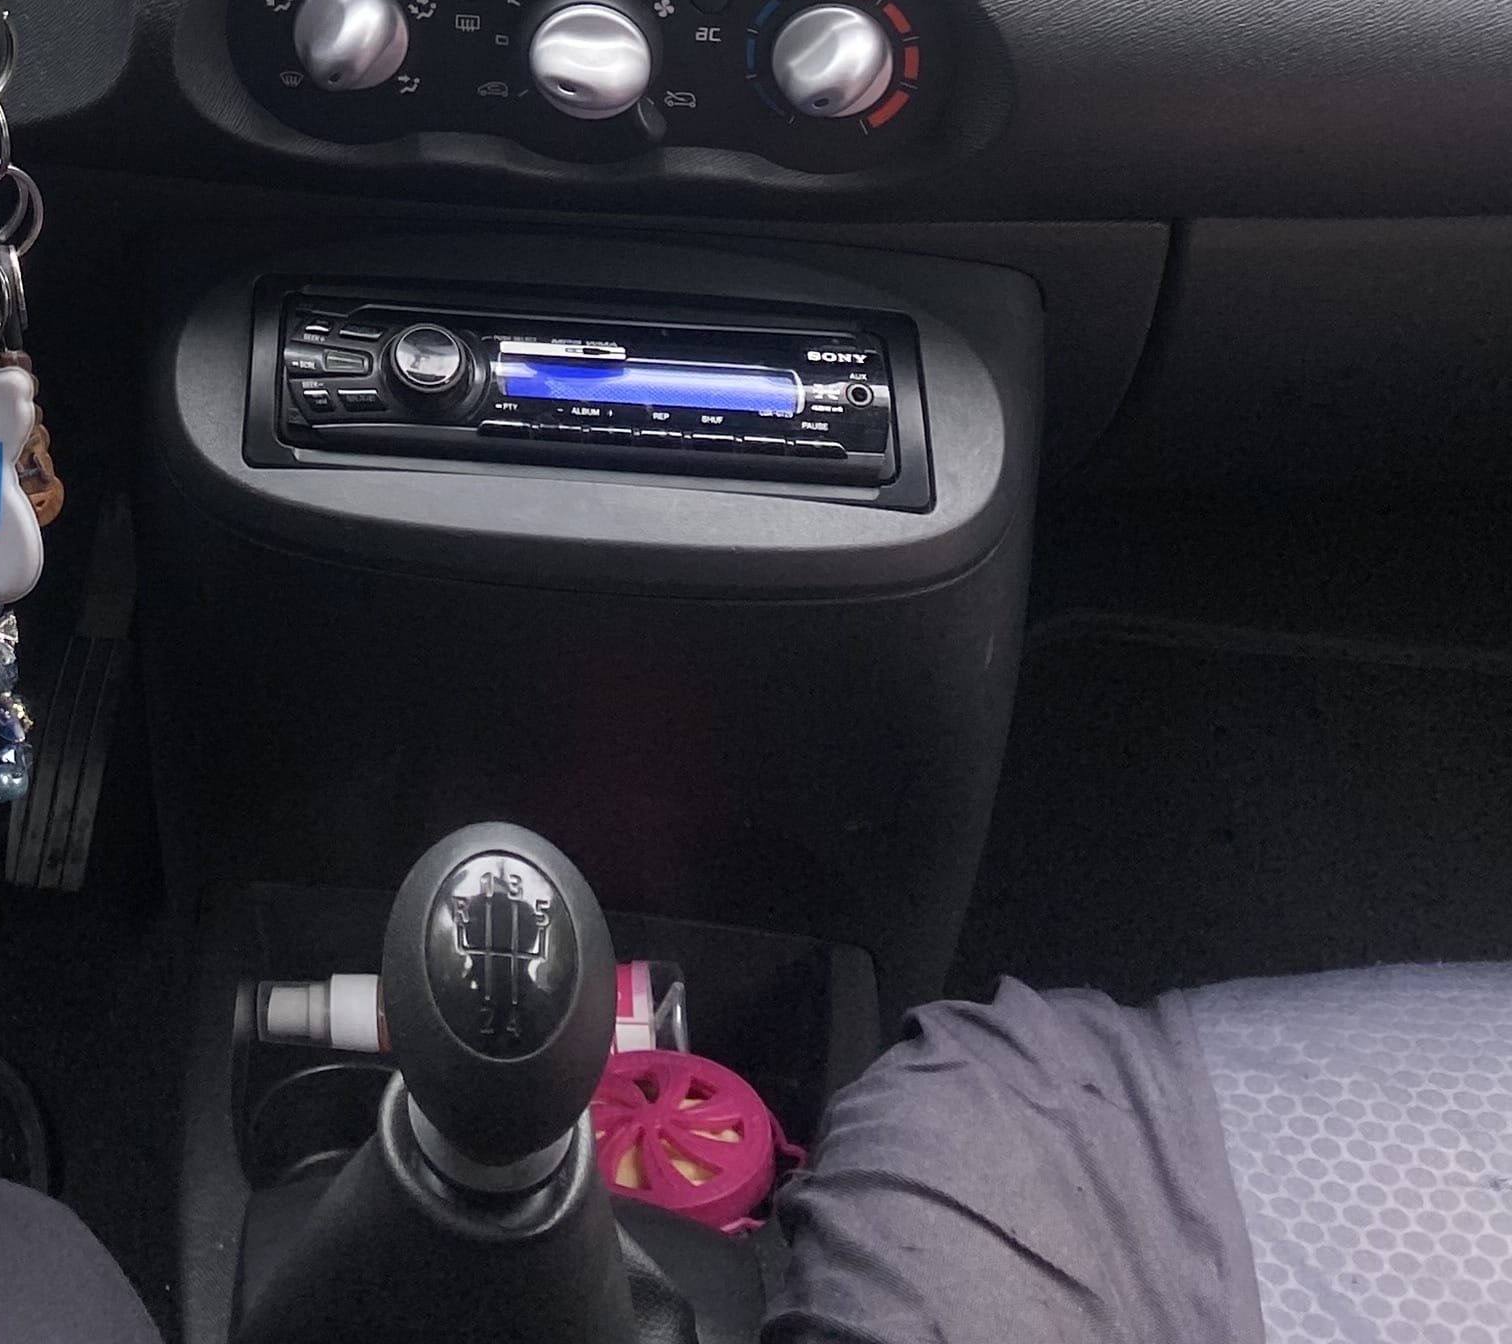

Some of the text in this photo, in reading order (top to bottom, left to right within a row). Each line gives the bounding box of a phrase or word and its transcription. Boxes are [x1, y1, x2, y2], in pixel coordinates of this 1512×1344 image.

[807, 350, 867, 364] SONY
[571, 407, 600, 417] ALBUM
[801, 421, 829, 431] PAUSE
[506, 873, 524, 900] 3
[535, 898, 551, 927] 5
